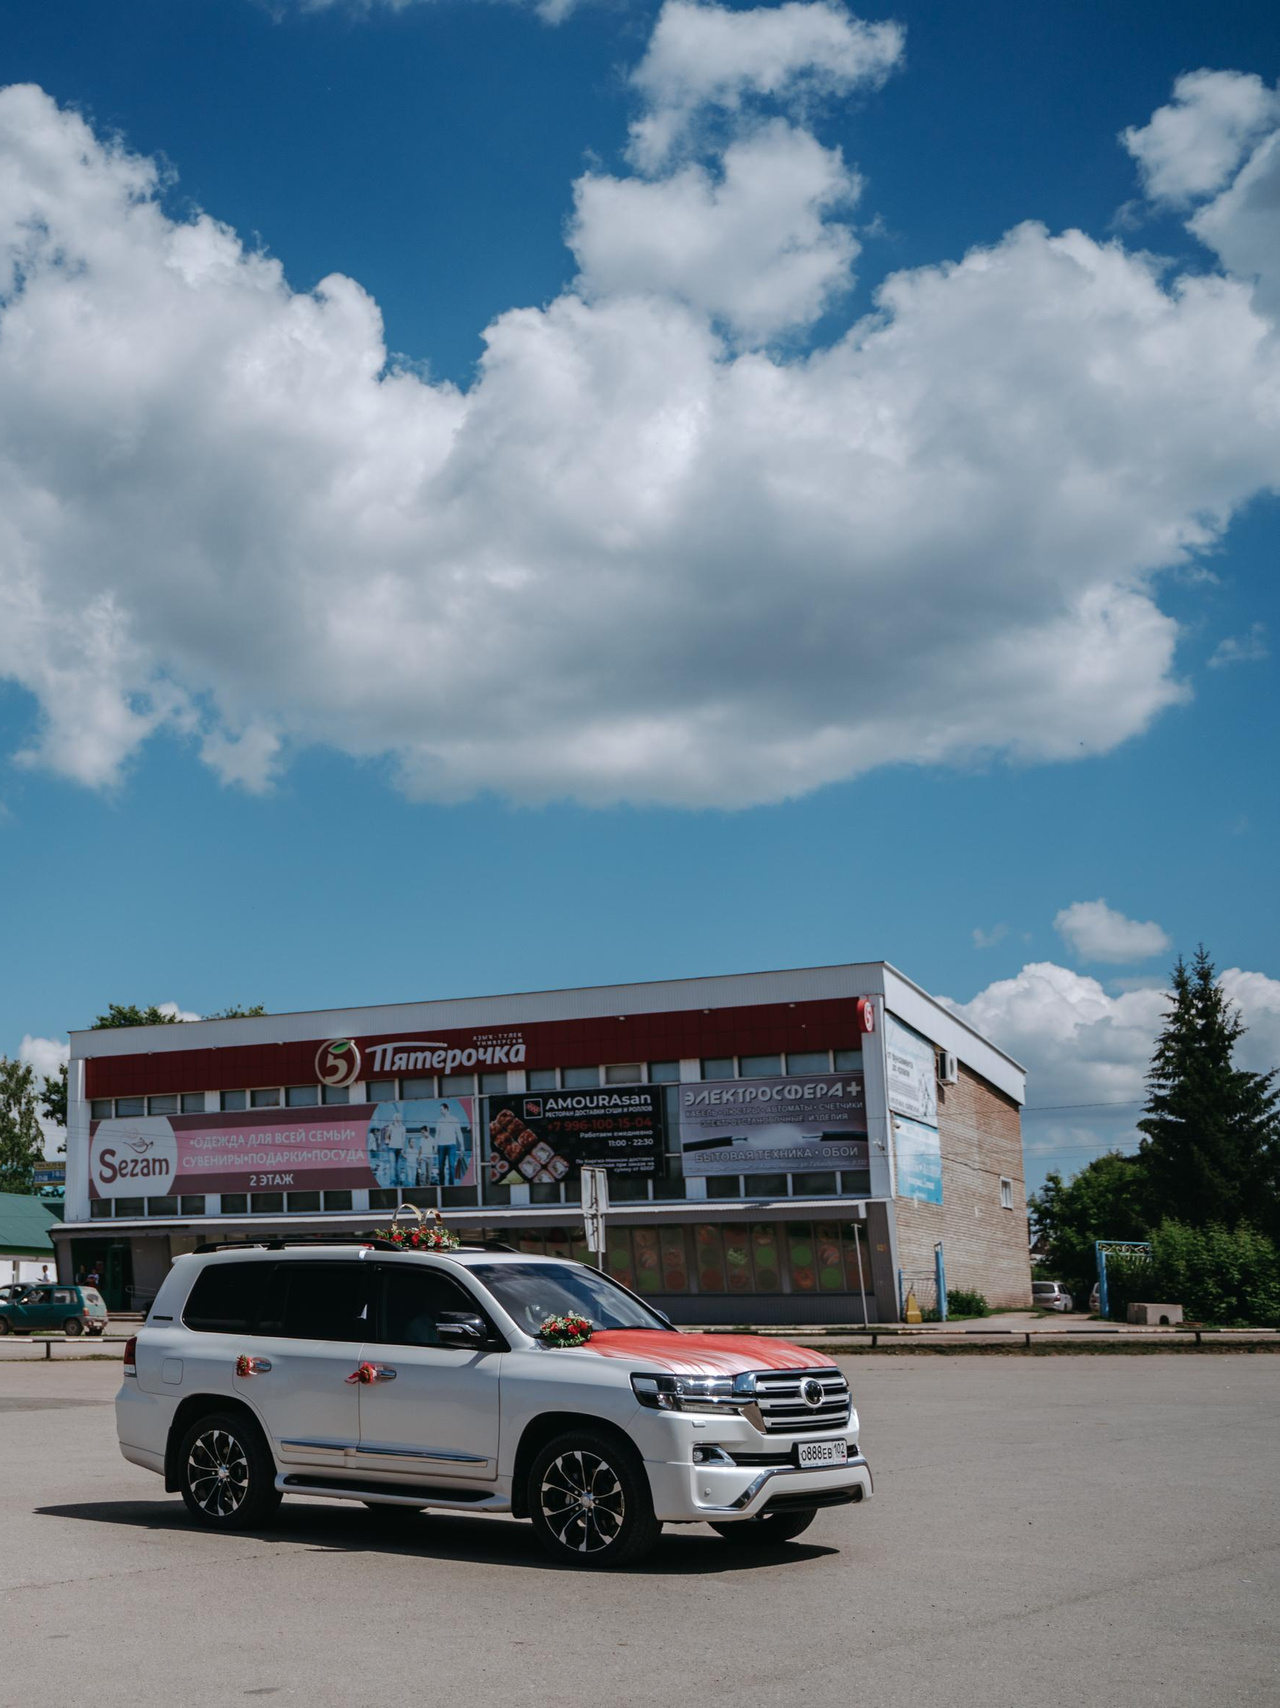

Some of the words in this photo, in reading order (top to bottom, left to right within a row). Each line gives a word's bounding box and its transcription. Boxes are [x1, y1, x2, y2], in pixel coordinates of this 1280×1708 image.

[325, 1053, 348, 1083] 5
[545, 1094, 651, 1110] AMOURAsan
[685, 1110, 718, 1118] КАБЕЛЬ
[723, 1108, 761, 1116] ЛЮСТРЫ
[765, 1105, 813, 1113] АВТОМАТЫ
[819, 1101, 863, 1110] СЧЕТЧИКИ
[545, 1110, 574, 1118] РЕСТОРАН
[575, 1109, 605, 1117] ДОСТАВКИ
[606, 1107, 622, 1115] СУШИ
[629, 1105, 653, 1113] РОЛЛОВ
[548, 1121, 561, 1131] +7
[564, 1117, 652, 1131] 996-100-15-04
[700, 1115, 804, 1127] ЭЛЕКТРОУСТАНОВОЧНЫЕ
[808, 1113, 849, 1122] ИЗДЕЛИЯ
[194, 1136, 245, 1150] ОДЕЖДА
[248, 1133, 272, 1147] ДЛЯ
[275, 1128, 306, 1144] ВСЕЙ
[308, 1129, 350, 1142] СЕМЬИ
[613, 1129, 653, 1137] ежедневно
[608, 1139, 627, 1147] 11:00
[632, 1138, 654, 1147] 22:30
[182, 1154, 244, 1168] СУВЕНИРЫ
[248, 1151, 308, 1166] ПОДАРКИ
[312, 1148, 365, 1163] ПОСУДА
[695, 1152, 754, 1164] БЫТОВАЯ
[757, 1149, 812, 1161] ТЕХНИКА
[822, 1146, 858, 1158] ОБОИ
[99, 1149, 170, 1184] Sezam
[250, 1175, 257, 1186] 2
[259, 1174, 294, 1186] ЭТАЖ
[801, 1445, 833, 1461] О888ЕВ
[833, 1442, 845, 1454] 102
